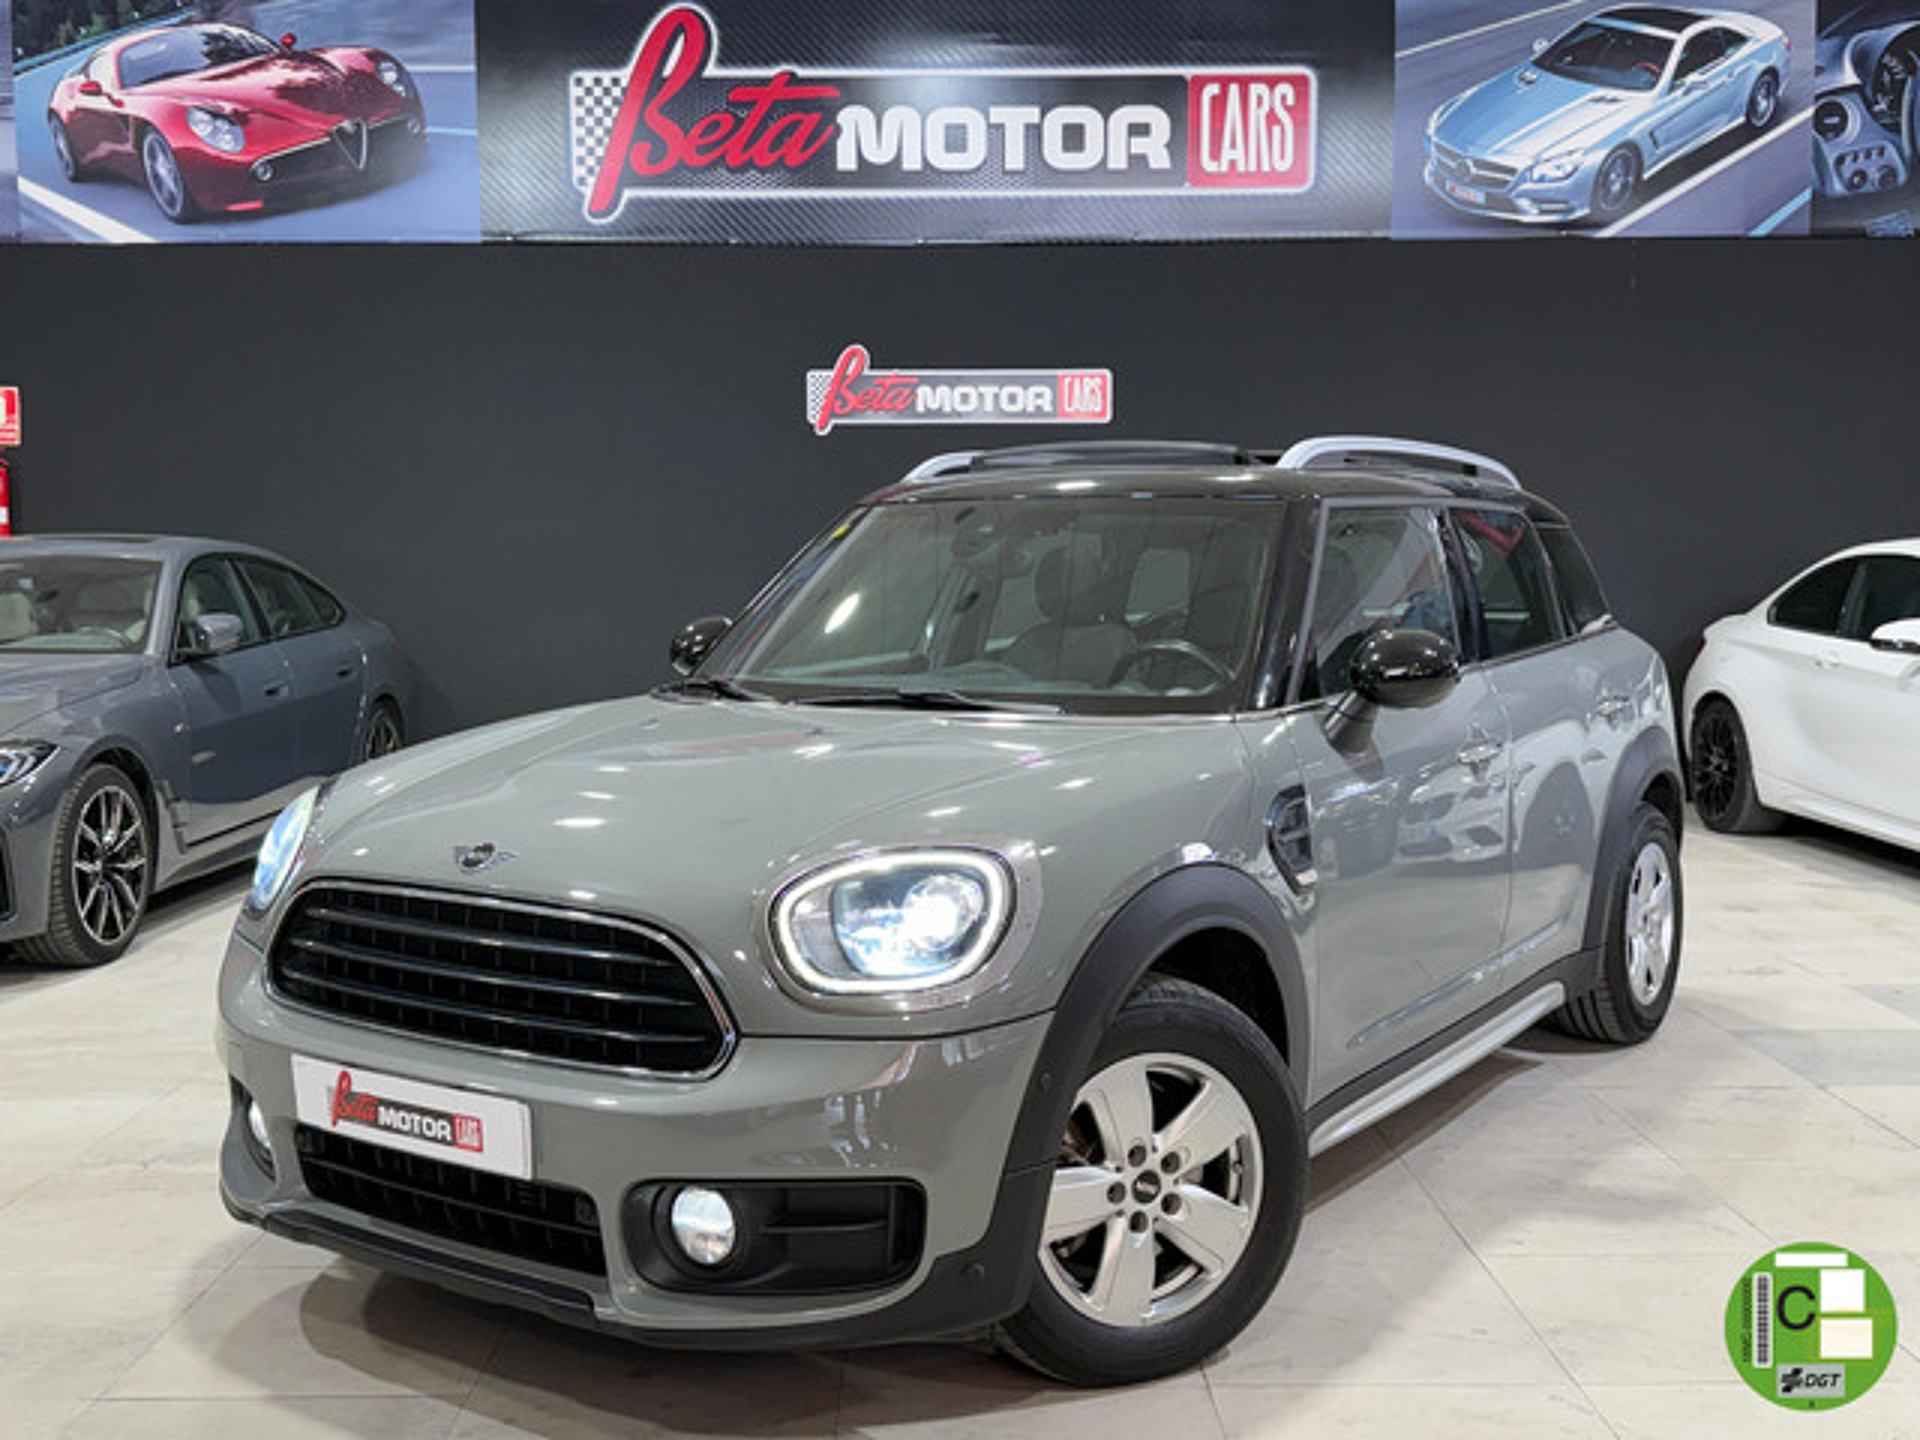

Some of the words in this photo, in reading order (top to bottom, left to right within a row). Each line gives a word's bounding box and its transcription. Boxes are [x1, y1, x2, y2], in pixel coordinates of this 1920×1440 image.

[835, 104, 1172, 171] MOTOR
[1200, 82, 1295, 174] CARS
[916, 384, 1053, 413] MOTOR
[1063, 376, 1103, 412] CARS
[377, 1105, 453, 1142] MOTOR
